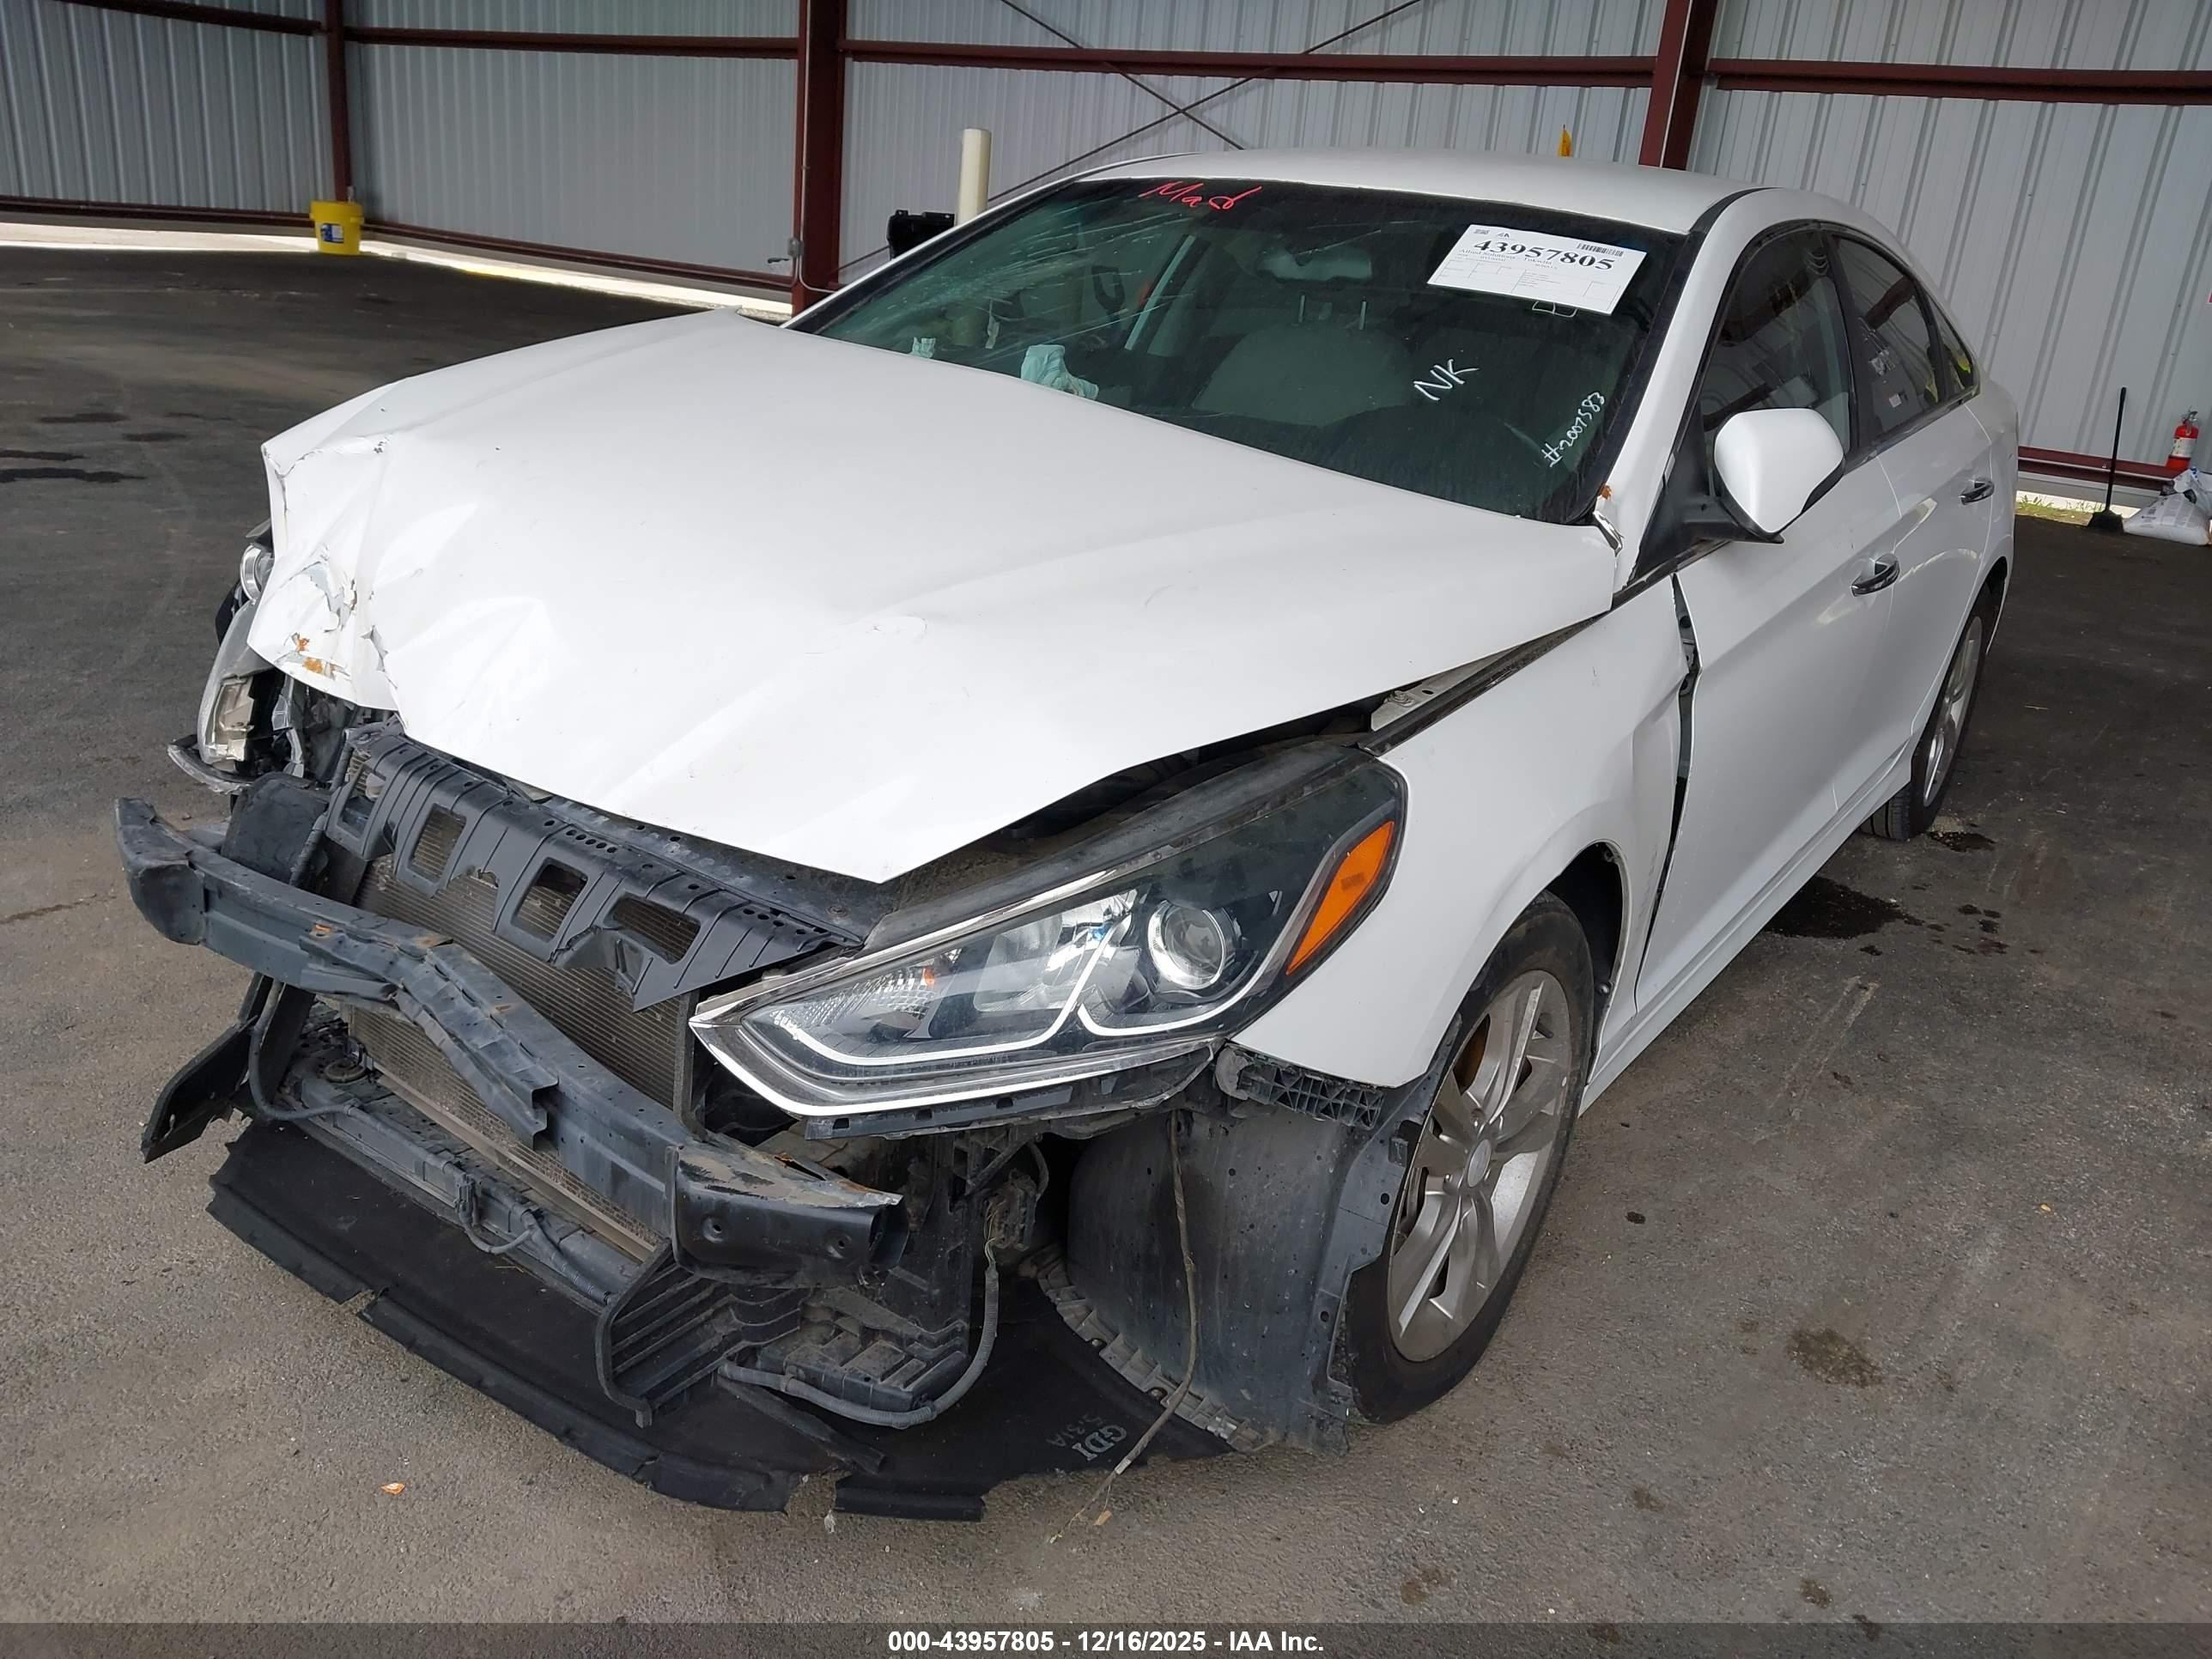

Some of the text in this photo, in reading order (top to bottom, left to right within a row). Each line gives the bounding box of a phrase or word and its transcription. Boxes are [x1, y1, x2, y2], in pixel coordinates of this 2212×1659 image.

[1474, 240, 1615, 270] 43957805
[1413, 358, 1480, 401] NK
[1072, 1425, 1127, 1461] GDI
